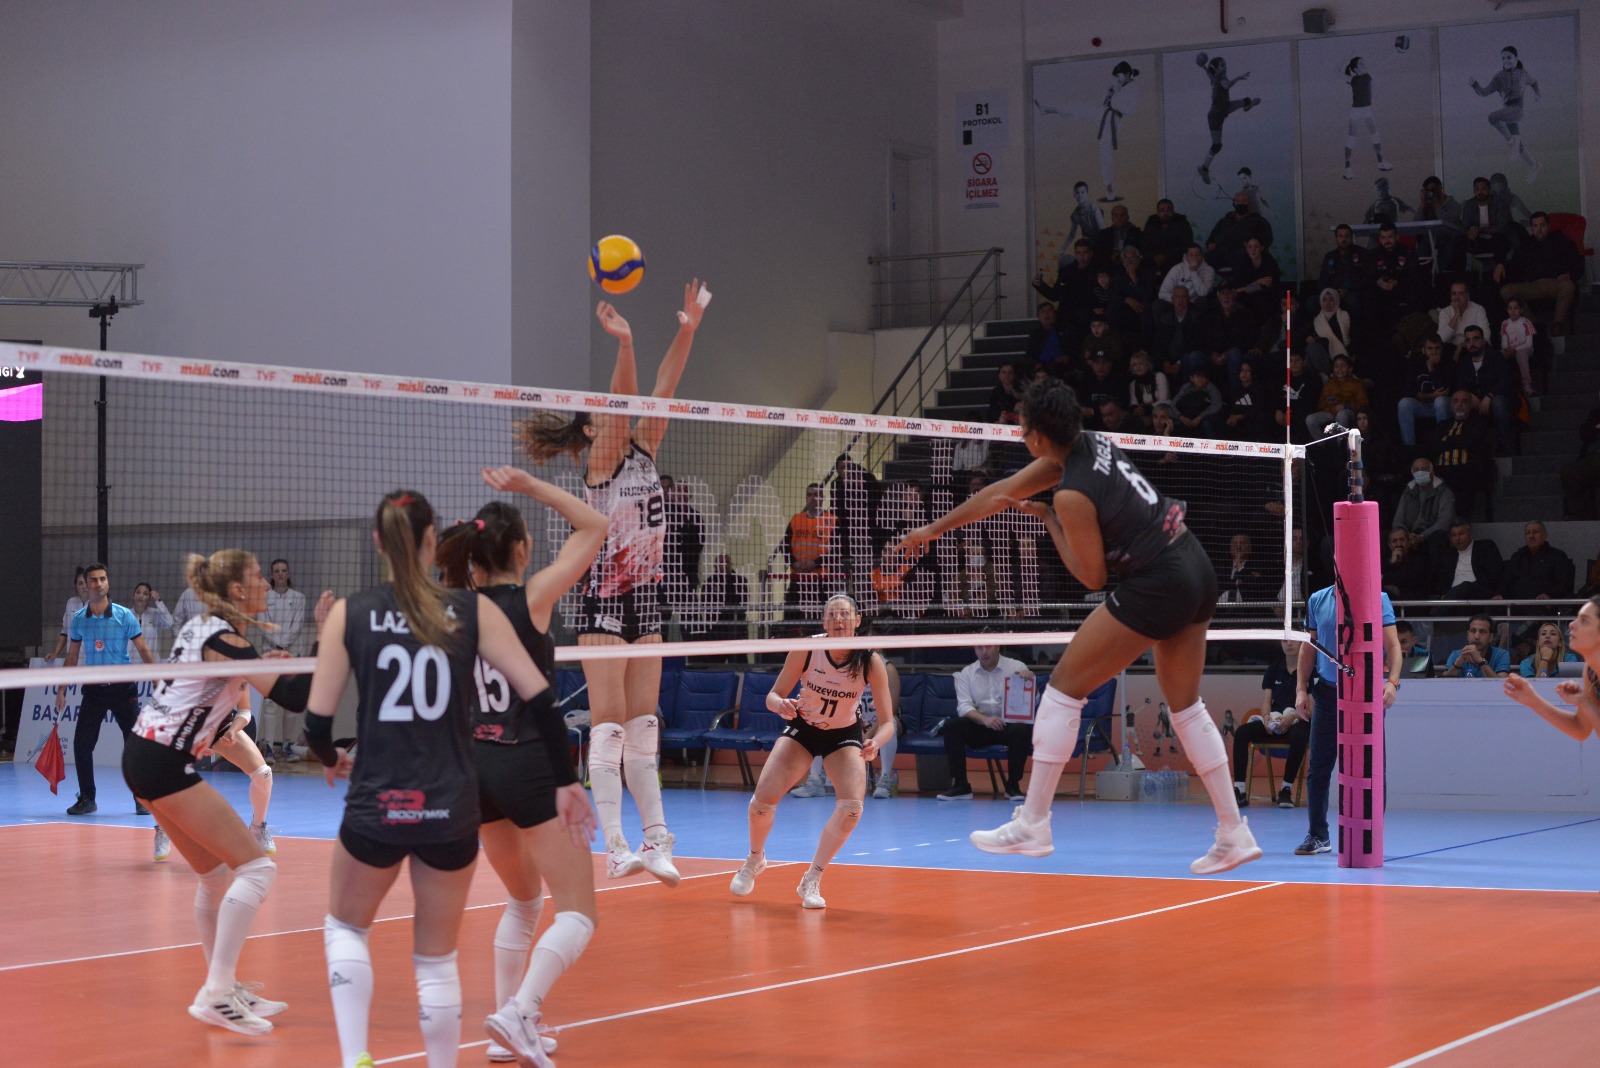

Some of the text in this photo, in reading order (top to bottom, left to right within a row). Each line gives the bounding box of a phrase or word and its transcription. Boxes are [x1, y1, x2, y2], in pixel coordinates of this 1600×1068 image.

[963, 117, 1002, 127] PROTOKOL
[976, 103, 989, 116] B1
[966, 188, 998, 200] İÇİLMEZ
[967, 177, 998, 188] SİGARA
[60, 353, 123, 369] misli.com
[180, 364, 240, 379] misli.com
[256, 370, 276, 382] TVF
[292, 372, 347, 387] misli.com
[363, 379, 382, 390] TVF
[397, 381, 448, 395] misli.com
[462, 387, 480, 398] TVF
[494, 389, 542, 402] misli.com
[584, 396, 629, 409] misli.com
[668, 402, 709, 415] misli.com
[721, 407, 735, 417] TVF
[746, 409, 785, 421] misli.com
[796, 413, 810, 423] TVF
[819, 415, 856, 427] misli.com
[865, 418, 878, 428] TVF
[887, 419, 922, 430] misli.com
[930, 423, 943, 433] TVF
[951, 425, 983, 435] misli.com
[1116, 460, 1158, 505] 6
[634, 495, 664, 530] 18
[376, 643, 452, 722] 20
[472, 653, 510, 713] 15
[806, 680, 858, 699] KUZEYBORU
